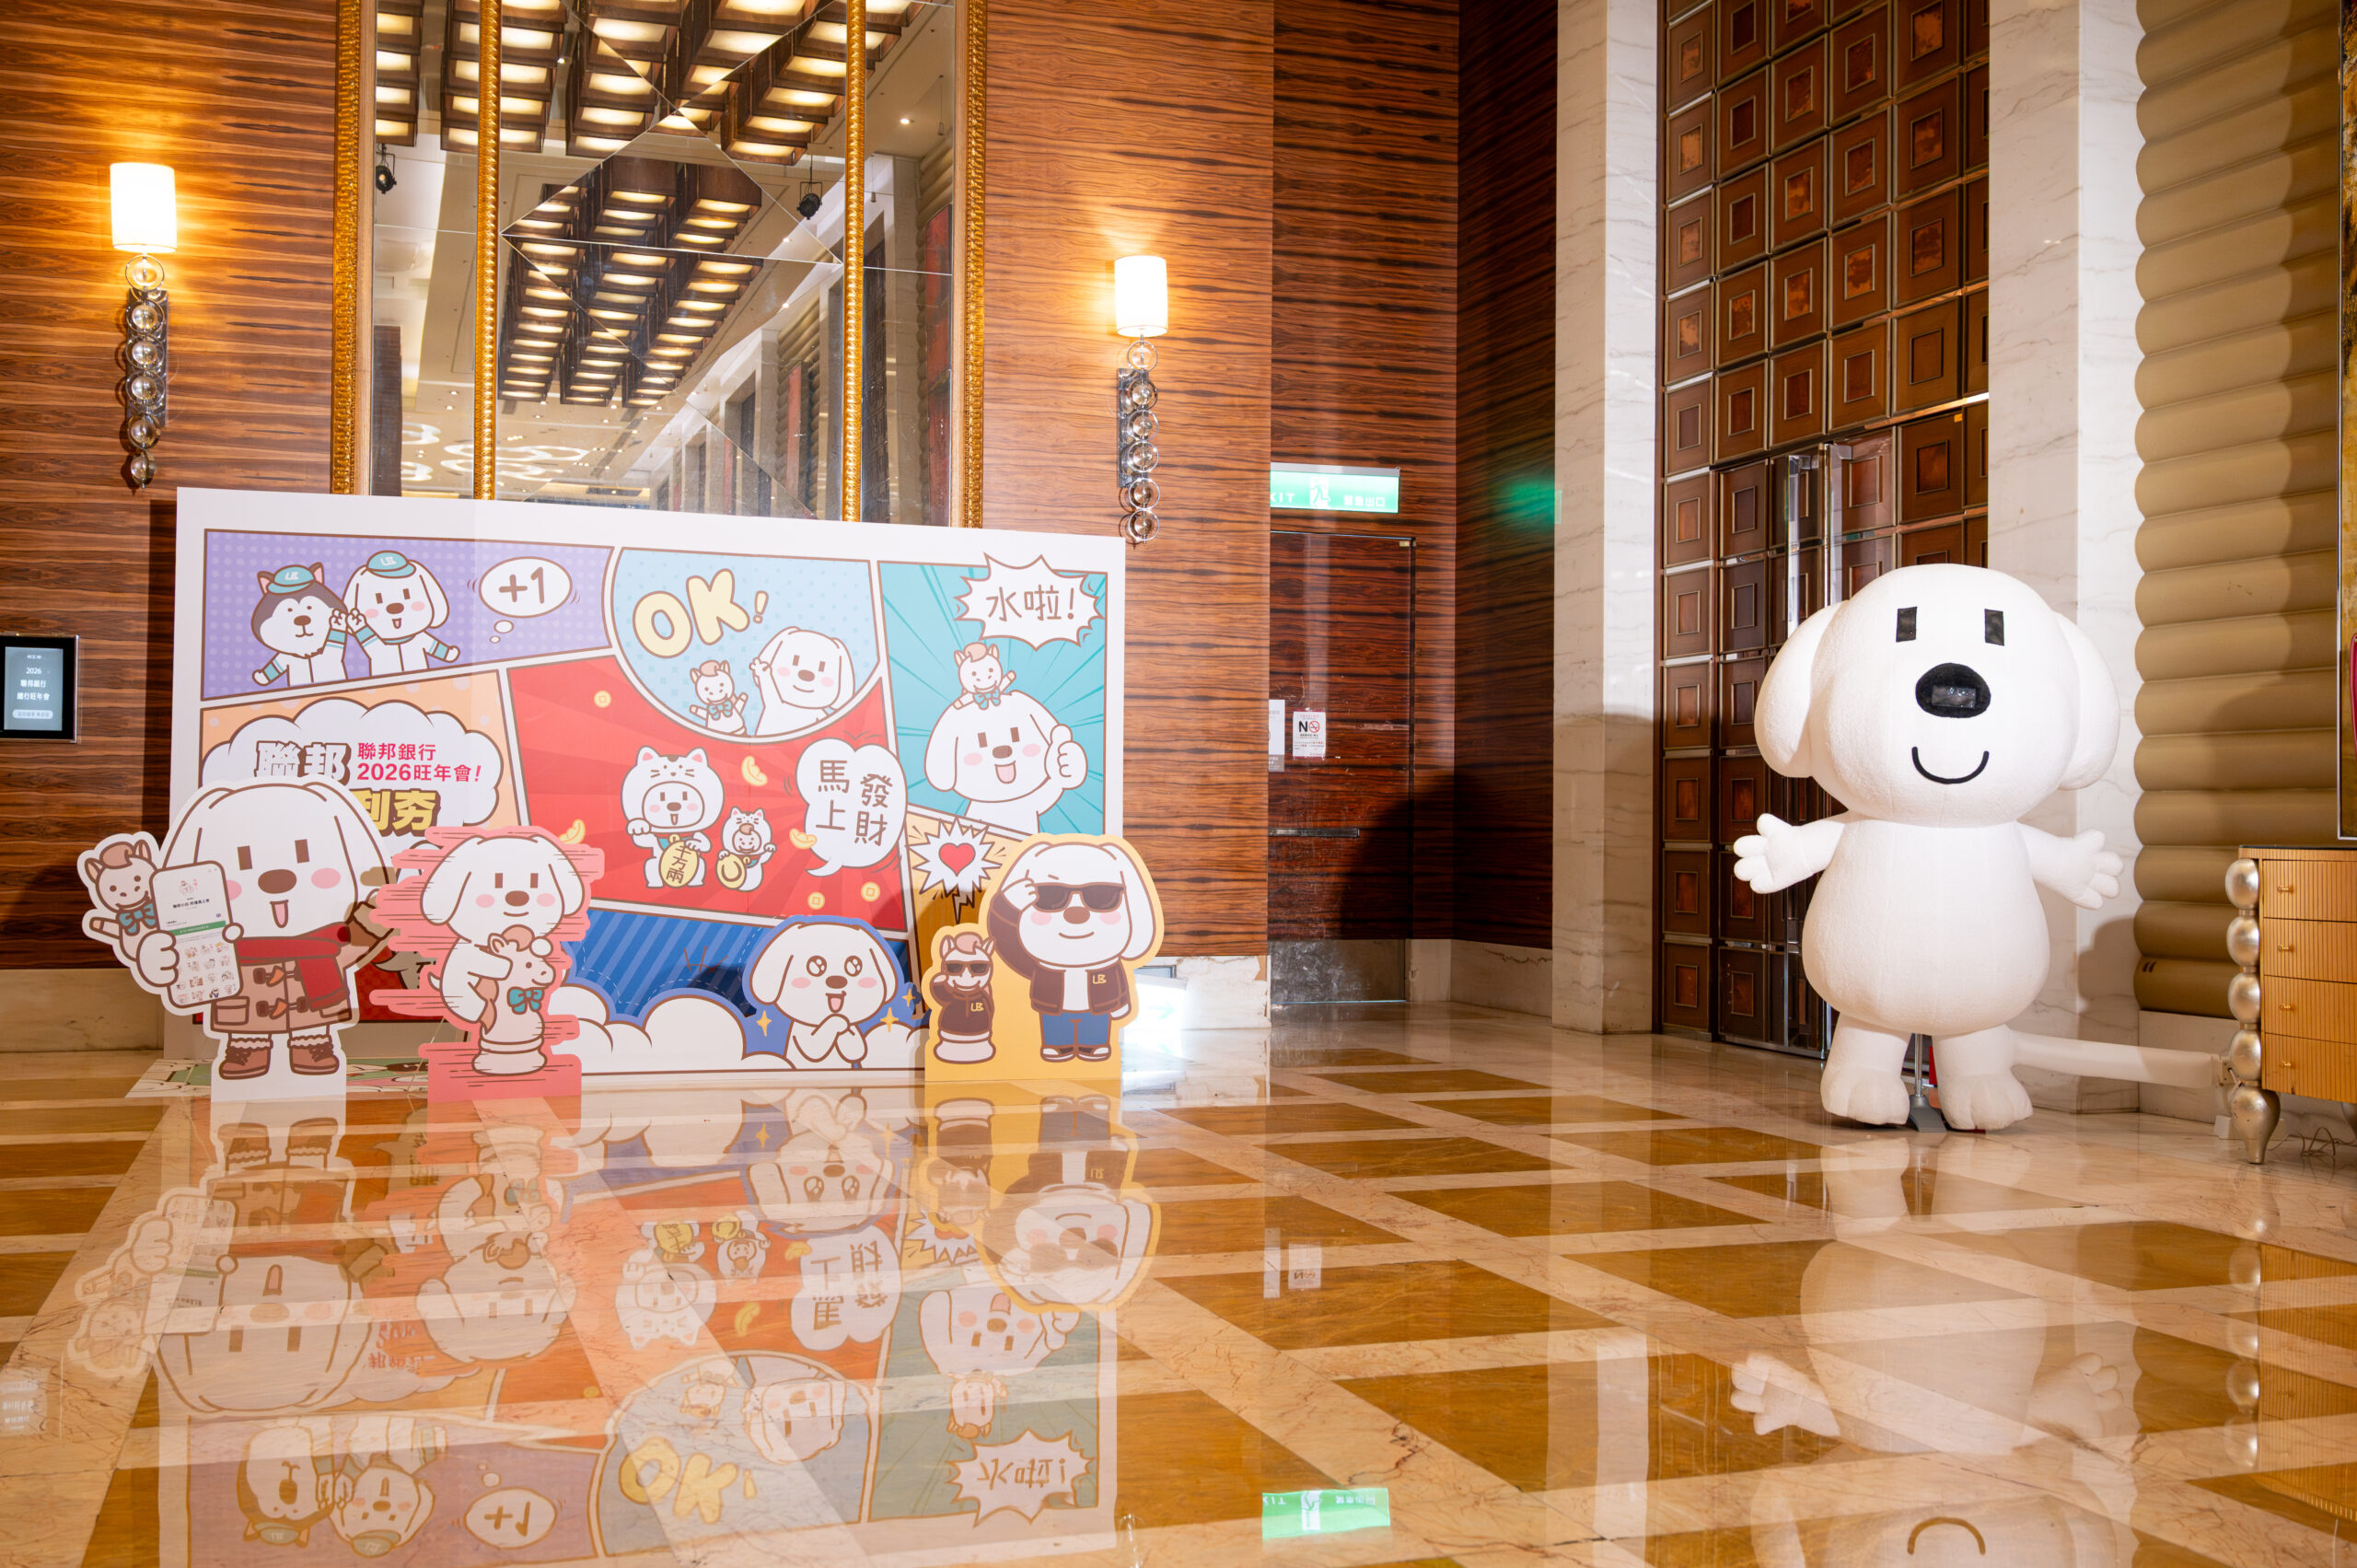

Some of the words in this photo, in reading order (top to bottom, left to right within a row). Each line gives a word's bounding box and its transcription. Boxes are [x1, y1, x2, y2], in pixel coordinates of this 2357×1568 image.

[1271, 493, 1295, 504] XIT
[498, 566, 546, 605] +1
[632, 568, 770, 659] OK!
[985, 584, 1074, 622] 水啦!
[26, 667, 42, 675] 2026
[254, 740, 351, 785] 聯邦
[357, 742, 436, 761] 聯邦銀行
[357, 762, 482, 783] 2026旺年會!
